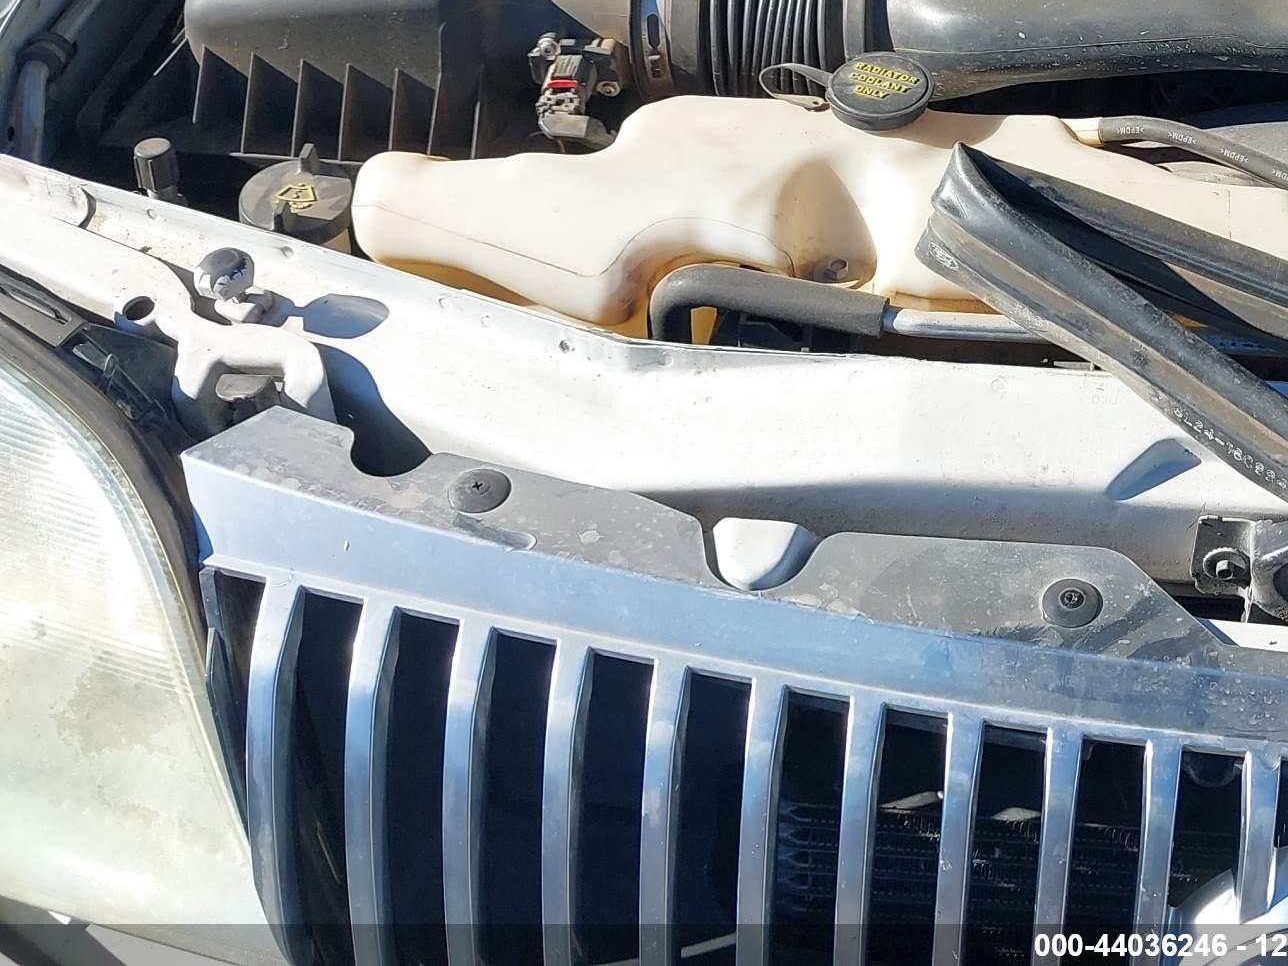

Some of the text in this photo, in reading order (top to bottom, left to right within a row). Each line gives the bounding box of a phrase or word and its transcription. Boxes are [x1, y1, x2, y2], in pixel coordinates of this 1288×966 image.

[848, 72, 913, 94] COOLANT
[856, 61, 922, 85] RADIATOR
[855, 85, 890, 100] ONLY
